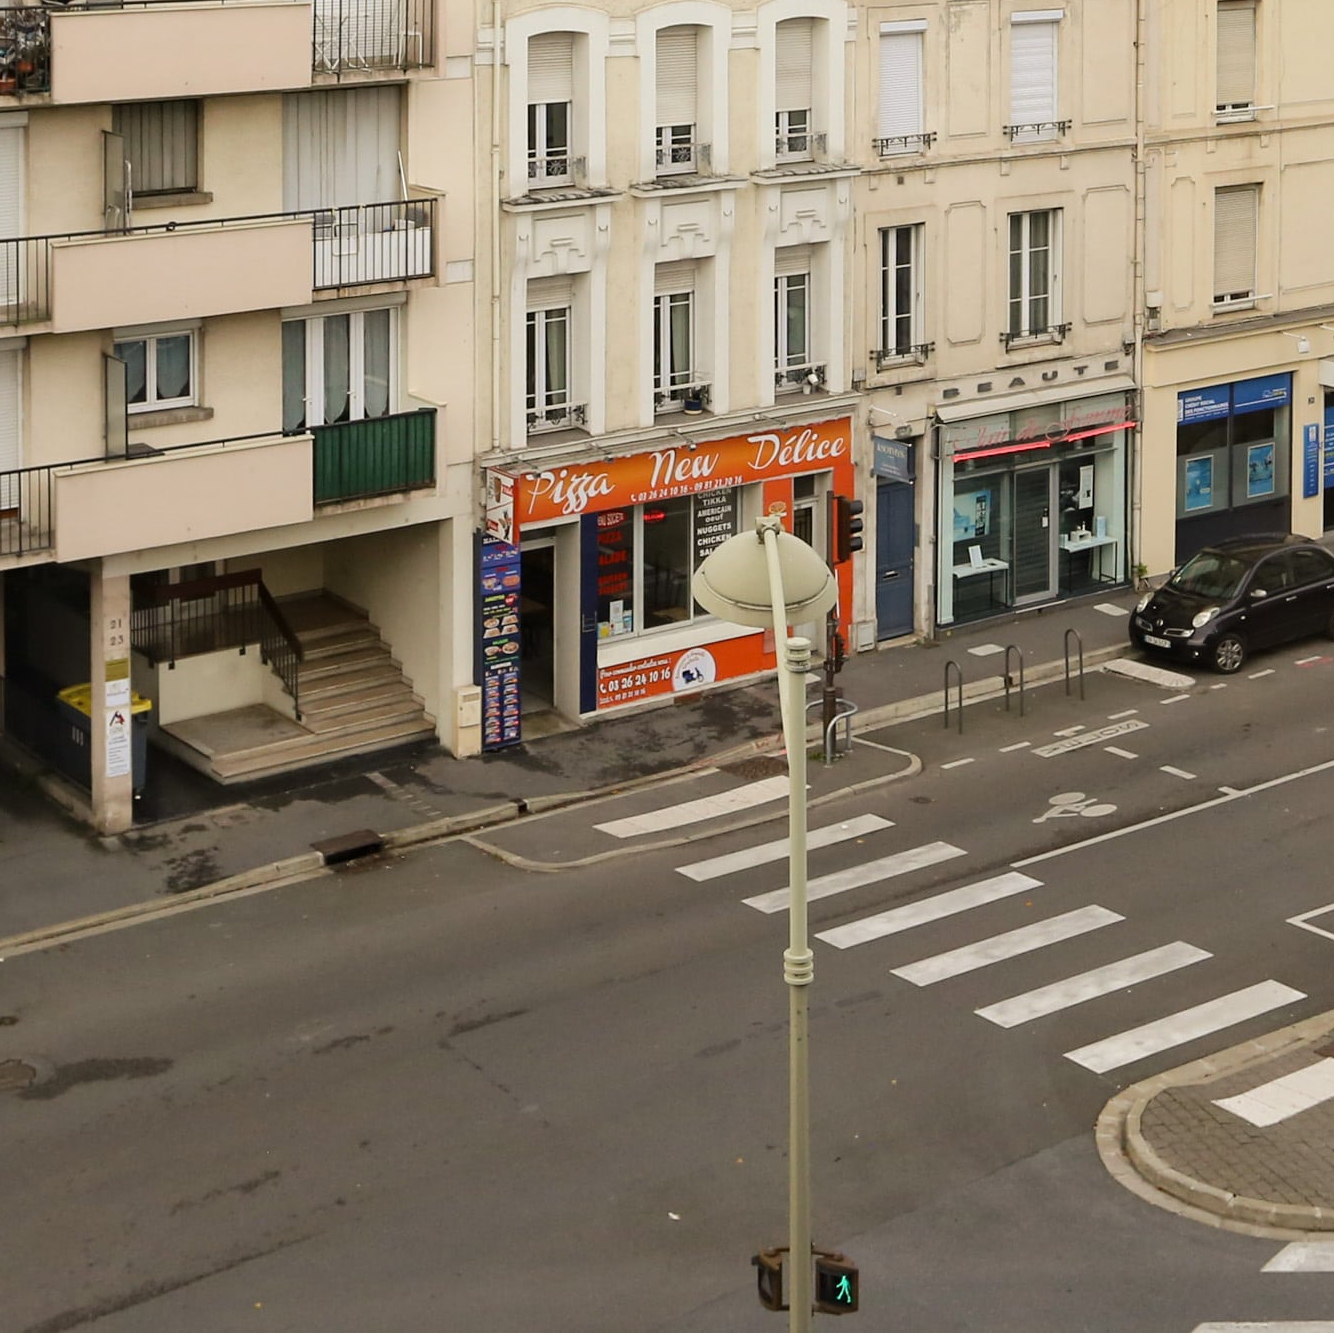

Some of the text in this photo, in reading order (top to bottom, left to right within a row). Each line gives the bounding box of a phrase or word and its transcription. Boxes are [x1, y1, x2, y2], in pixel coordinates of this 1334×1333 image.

[943, 360, 1119, 399] BEAUTE
[525, 469, 616, 515] Pizza
[648, 449, 720, 488] New
[747, 429, 846, 470] Délice
[637, 491, 648, 502] 03
[648, 489, 658, 500] 26
[659, 487, 668, 498] 24
[670, 486, 679, 496] 10
[680, 484, 688, 494] 16
[694, 482, 703, 492] 09
[703, 496, 726, 506] TIKKA
[698, 505, 732, 518] AMERICAIN
[705, 514, 724, 523] oeuf
[697, 522, 732, 535] NUGGETS
[697, 533, 732, 546] CHICKEN
[110, 618, 122, 629] 21
[110, 635, 123, 646] 23
[608, 667, 671, 692] 03 26 24 10 16
